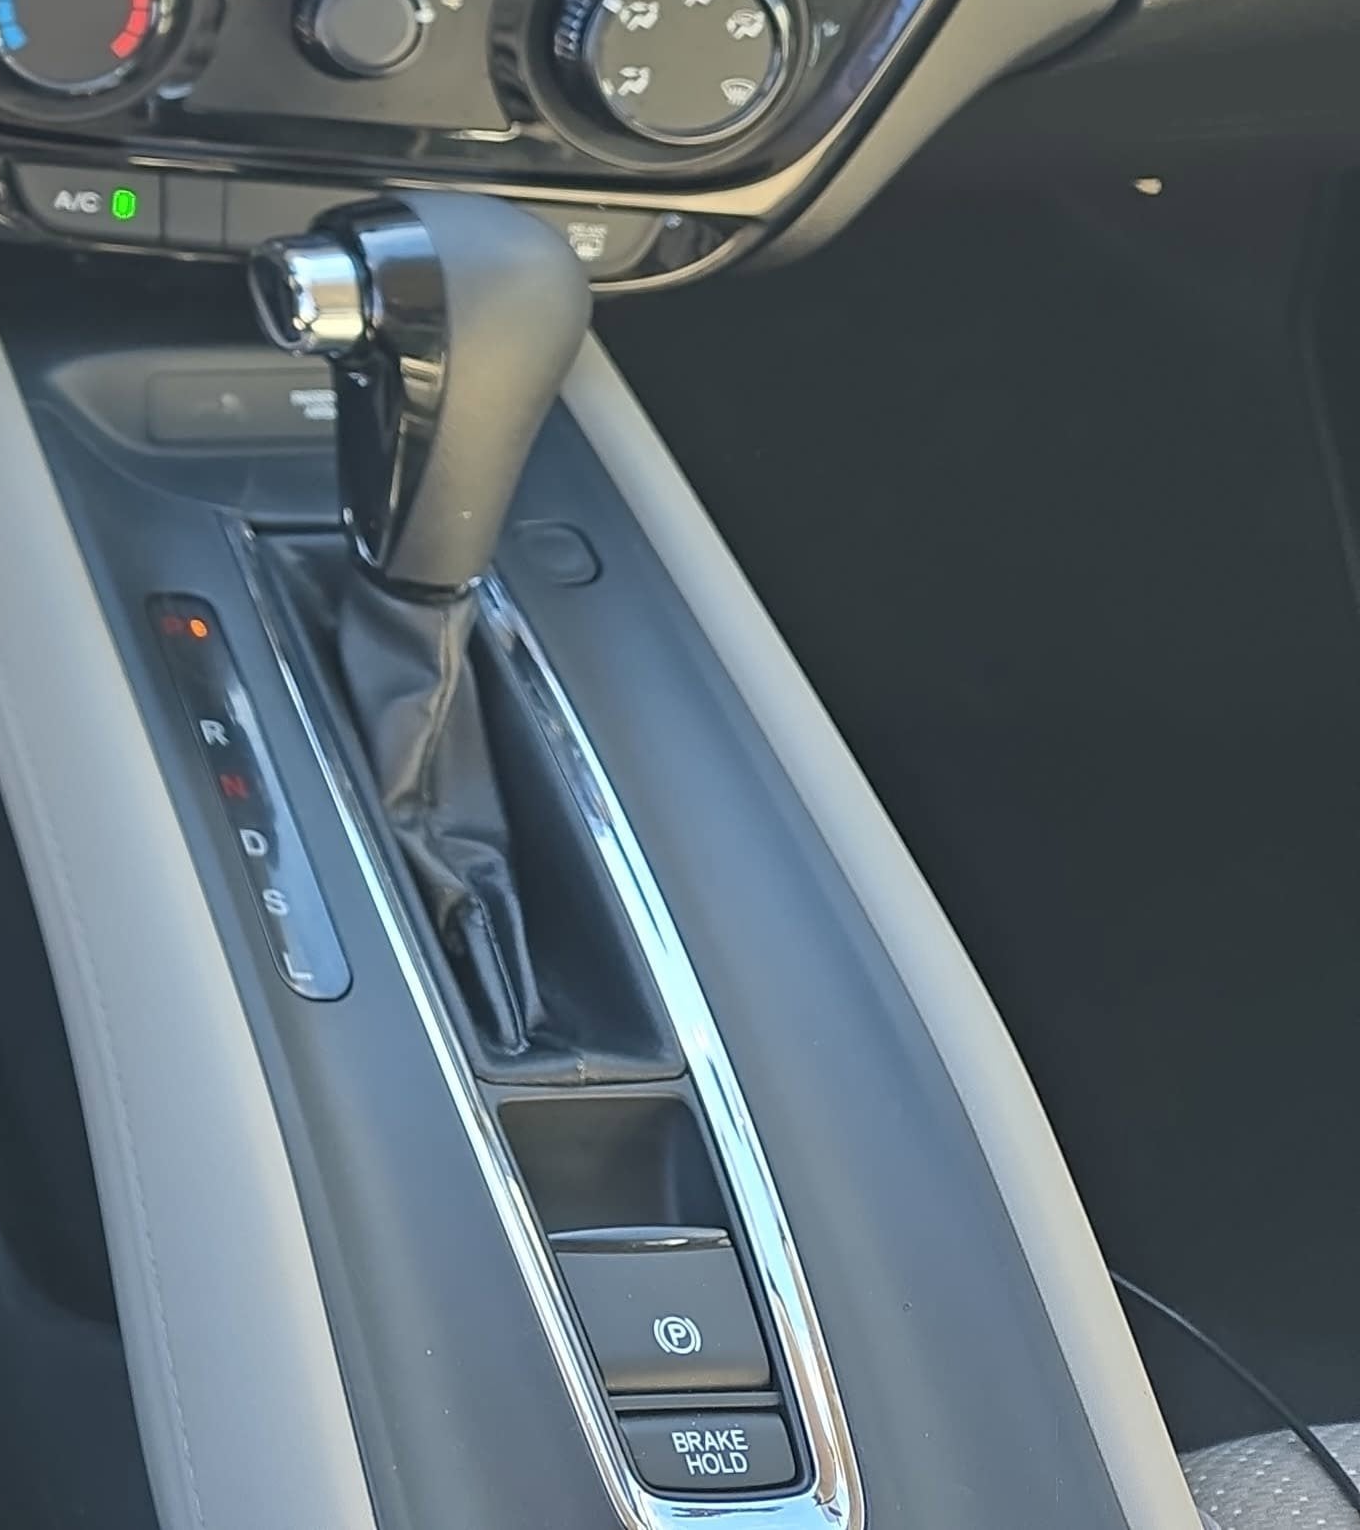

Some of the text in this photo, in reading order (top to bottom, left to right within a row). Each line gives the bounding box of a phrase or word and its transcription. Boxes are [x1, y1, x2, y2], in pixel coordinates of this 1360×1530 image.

[52, 191, 103, 214] A/C
[199, 719, 230, 747] R
[220, 773, 249, 799] N
[239, 828, 269, 857] D
[262, 888, 290, 917] S
[282, 952, 314, 982] L
[671, 1429, 749, 1454] BRAKE
[685, 1452, 748, 1476] HOLD
